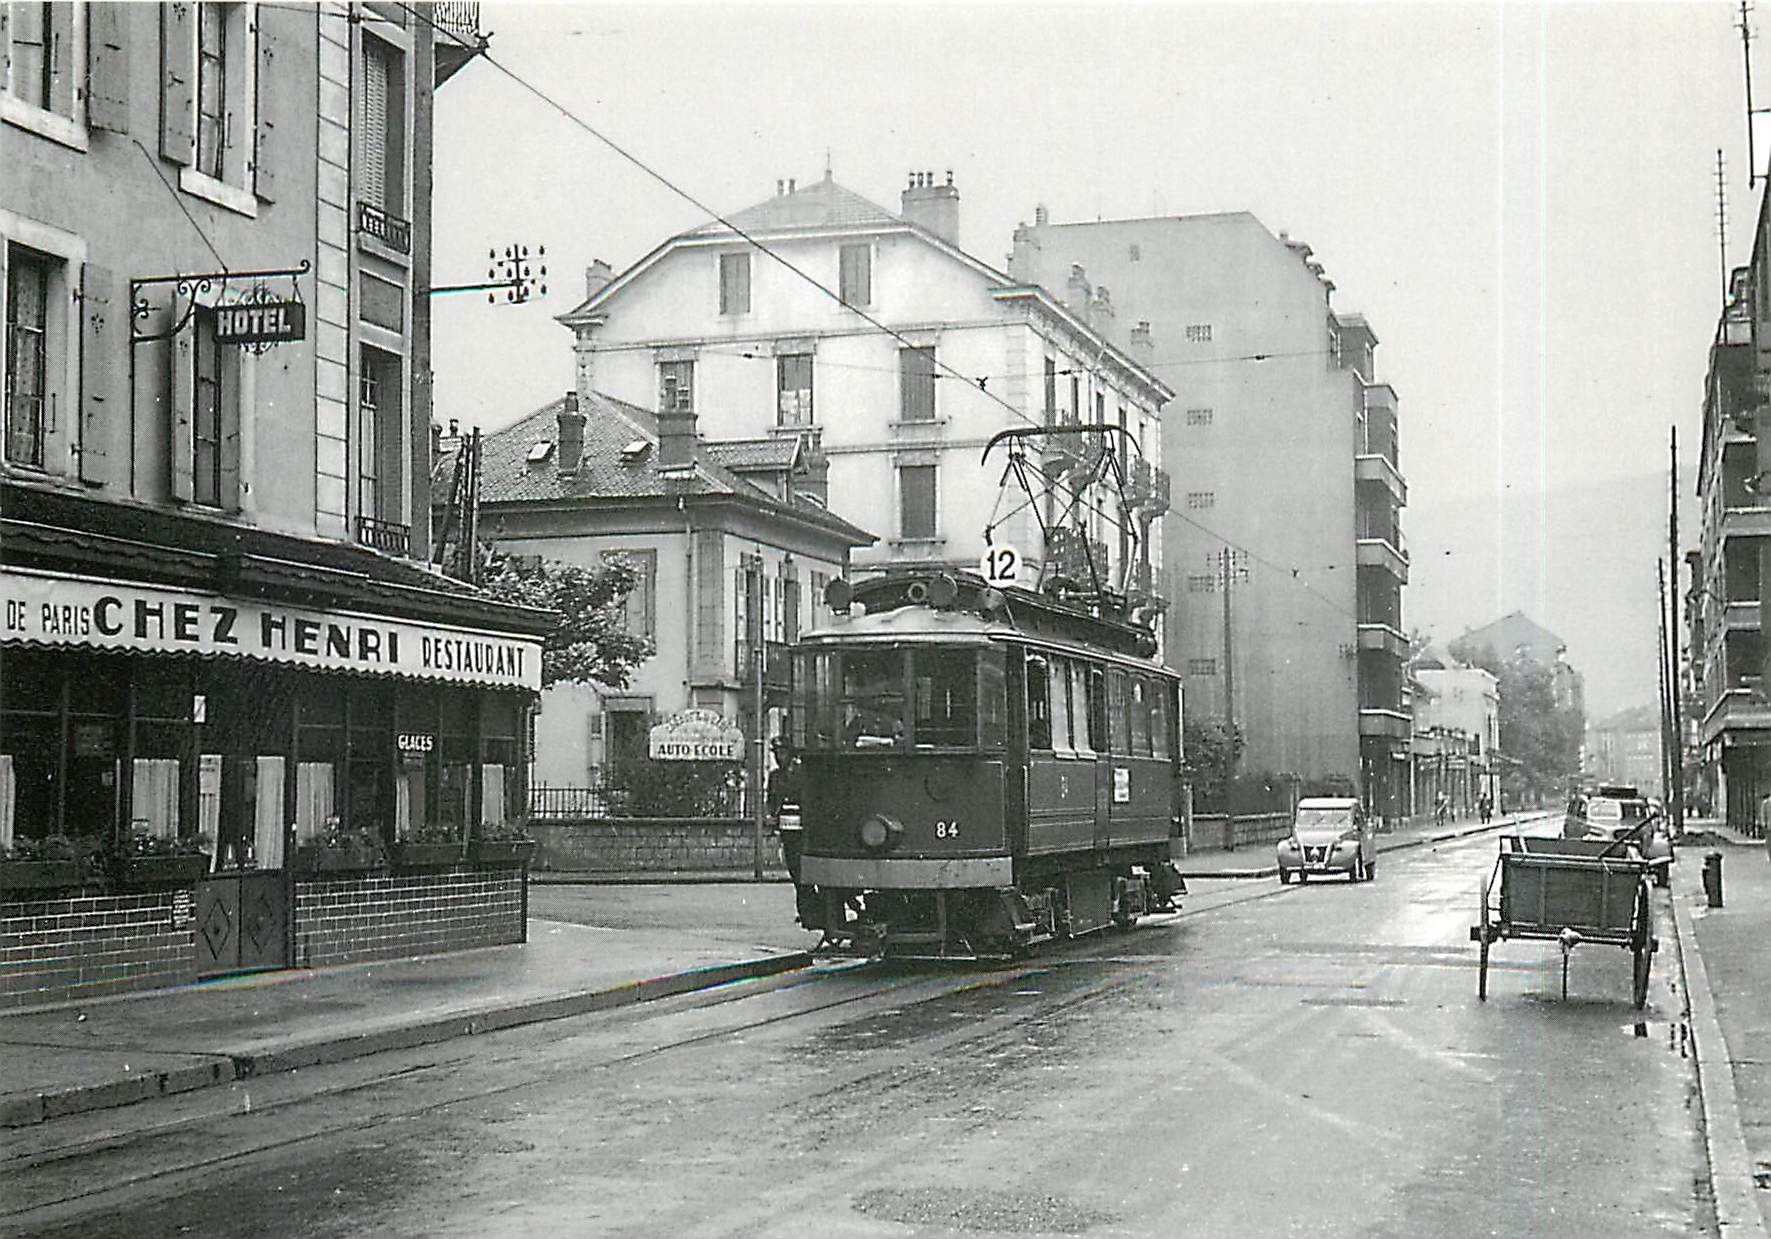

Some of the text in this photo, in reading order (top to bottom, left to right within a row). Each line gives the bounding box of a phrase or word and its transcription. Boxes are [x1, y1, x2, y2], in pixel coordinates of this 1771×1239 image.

[218, 307, 291, 336] HOTEL
[987, 550, 1016, 580] 12
[7, 600, 90, 635] DE PARIS
[94, 596, 399, 664] CHEZ HENRI
[422, 637, 525, 679] RESTAURANT
[398, 734, 433, 751] GLACES
[658, 744, 733, 756] AUTO ECOLE
[937, 821, 958, 838] 84
